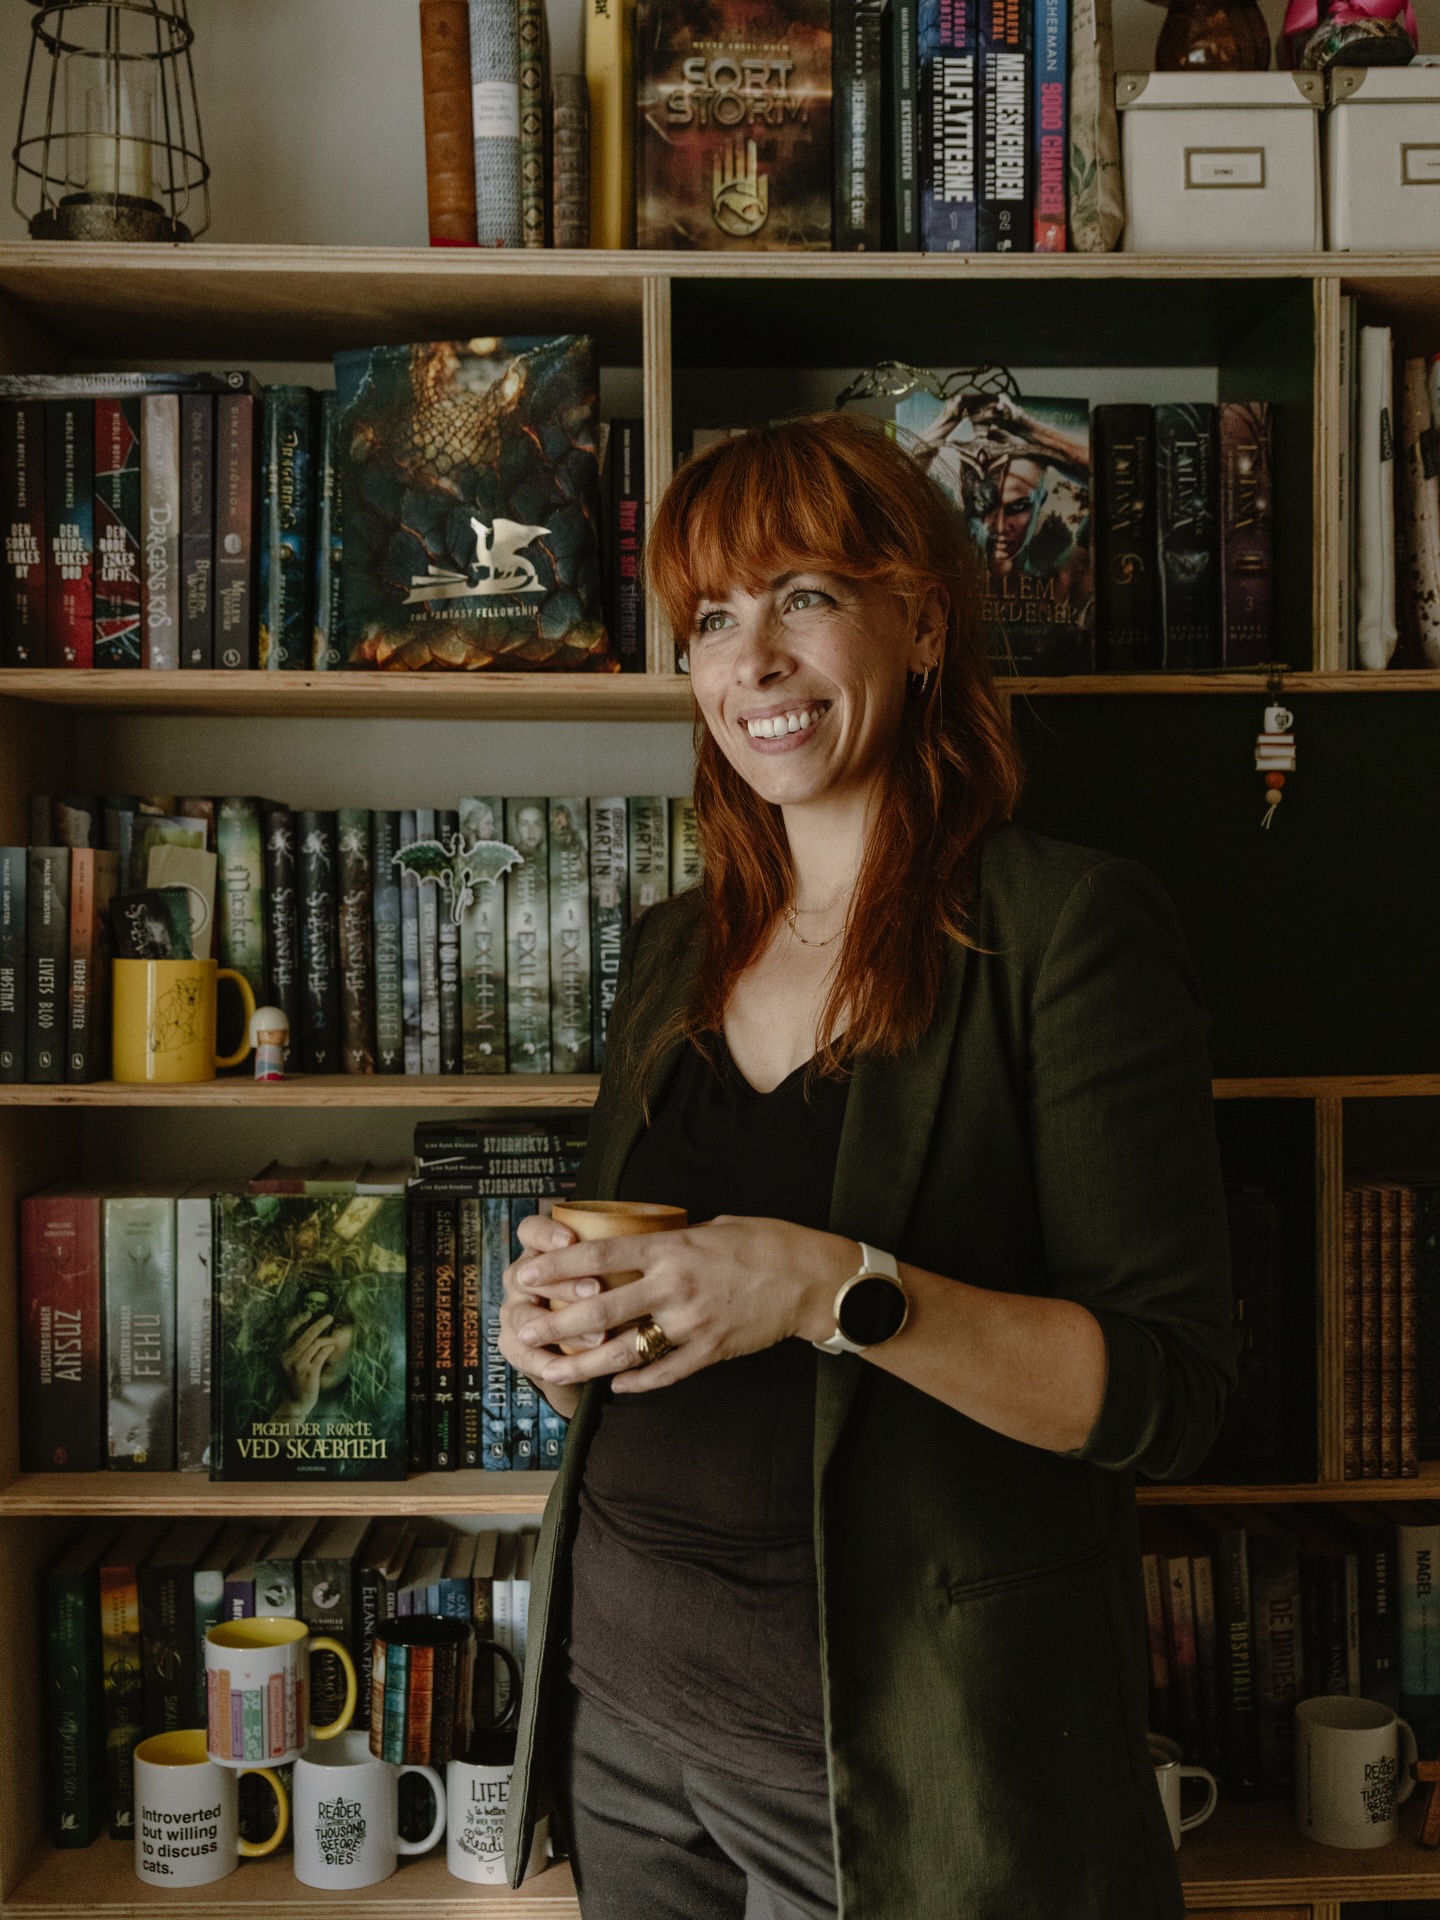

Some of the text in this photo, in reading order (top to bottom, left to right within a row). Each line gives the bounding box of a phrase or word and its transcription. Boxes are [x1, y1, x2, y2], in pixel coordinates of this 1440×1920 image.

[1046, 0, 1059, 72] SHERMAN
[682, 57, 793, 98] SORT
[932, 56, 943, 91] EFTER
[985, 53, 996, 88] EFTER
[667, 89, 809, 125] STORM
[943, 56, 973, 202] TILFLYTTERNE
[996, 53, 1024, 200] MENNESKEHEDEN
[932, 143, 943, 160] OM
[985, 141, 996, 158] OM
[1041, 83, 1063, 214] 9000 CHANCER
[999, 211, 1010, 231] 2
[11, 523, 31, 537] DEN
[59, 523, 80, 538] DEN
[106, 524, 127, 538] DEN
[5, 536, 38, 550] SORTE
[146, 503, 173, 590] DRAGENS
[7, 550, 41, 564] ENKES
[55, 551, 89, 566] ENKES
[103, 552, 136, 567] ENKES
[476, 605, 539, 618] FELLOWSHIP
[595, 808, 611, 876] MARTIN
[635, 807, 652, 875] MARTIN
[684, 807, 700, 875] MARTIN
[600, 923, 621, 973] WILD
[38, 958, 55, 994] LIVETS
[376, 923, 398, 1041] SKÆBNEBREVET
[483, 1136, 550, 1153] STJERNEKYS
[488, 1157, 555, 1175] STJERNEKYS
[478, 1178, 545, 1195] STJERNEKYS
[54, 1309, 82, 1382] ANSUZ
[133, 1314, 161, 1376] FEHU
[251, 1420, 373, 1436] PIGEN DER RØRTE
[236, 1438, 388, 1459] VED SKÆBNEN
[1416, 1550, 1431, 1599] NAGEL
[336, 1797, 343, 1806] A
[472, 1779, 509, 1803] LIFE
[142, 1803, 221, 1825] introverted
[318, 1802, 361, 1820] READER
[142, 1823, 217, 1842] but willing
[315, 1819, 366, 1841] THOUSAND
[142, 1841, 218, 1858] to discuss
[321, 1838, 362, 1853] BEFORE
[463, 1828, 504, 1854] Readi
[143, 1860, 174, 1875] cats.
[325, 1852, 354, 1865] DIES
